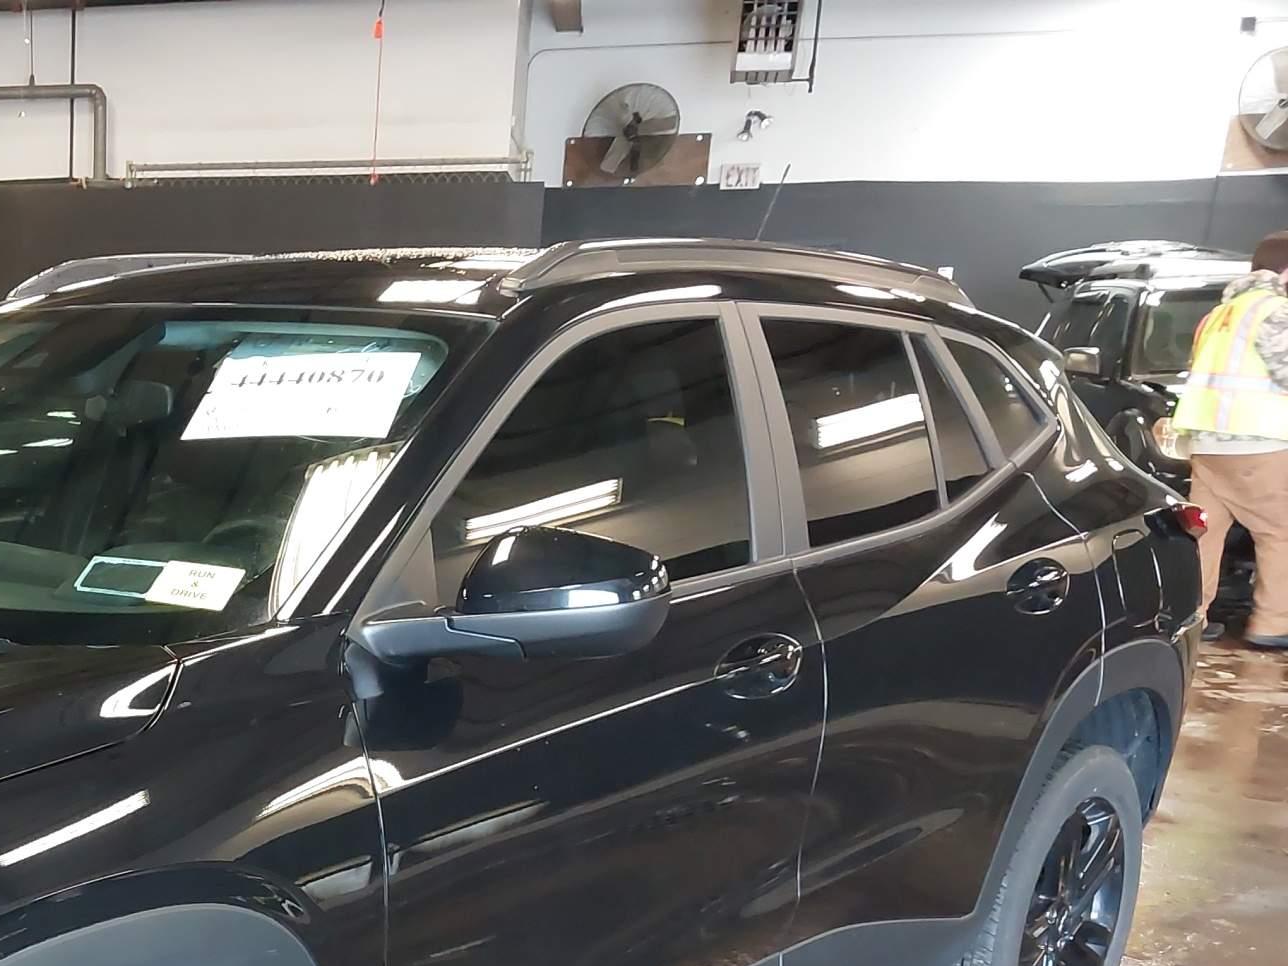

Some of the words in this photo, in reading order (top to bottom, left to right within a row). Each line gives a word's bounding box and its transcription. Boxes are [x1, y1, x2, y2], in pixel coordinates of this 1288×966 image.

[726, 166, 759, 187] EXIT
[188, 569, 216, 579] RUN
[170, 588, 209, 600] DRIVE
